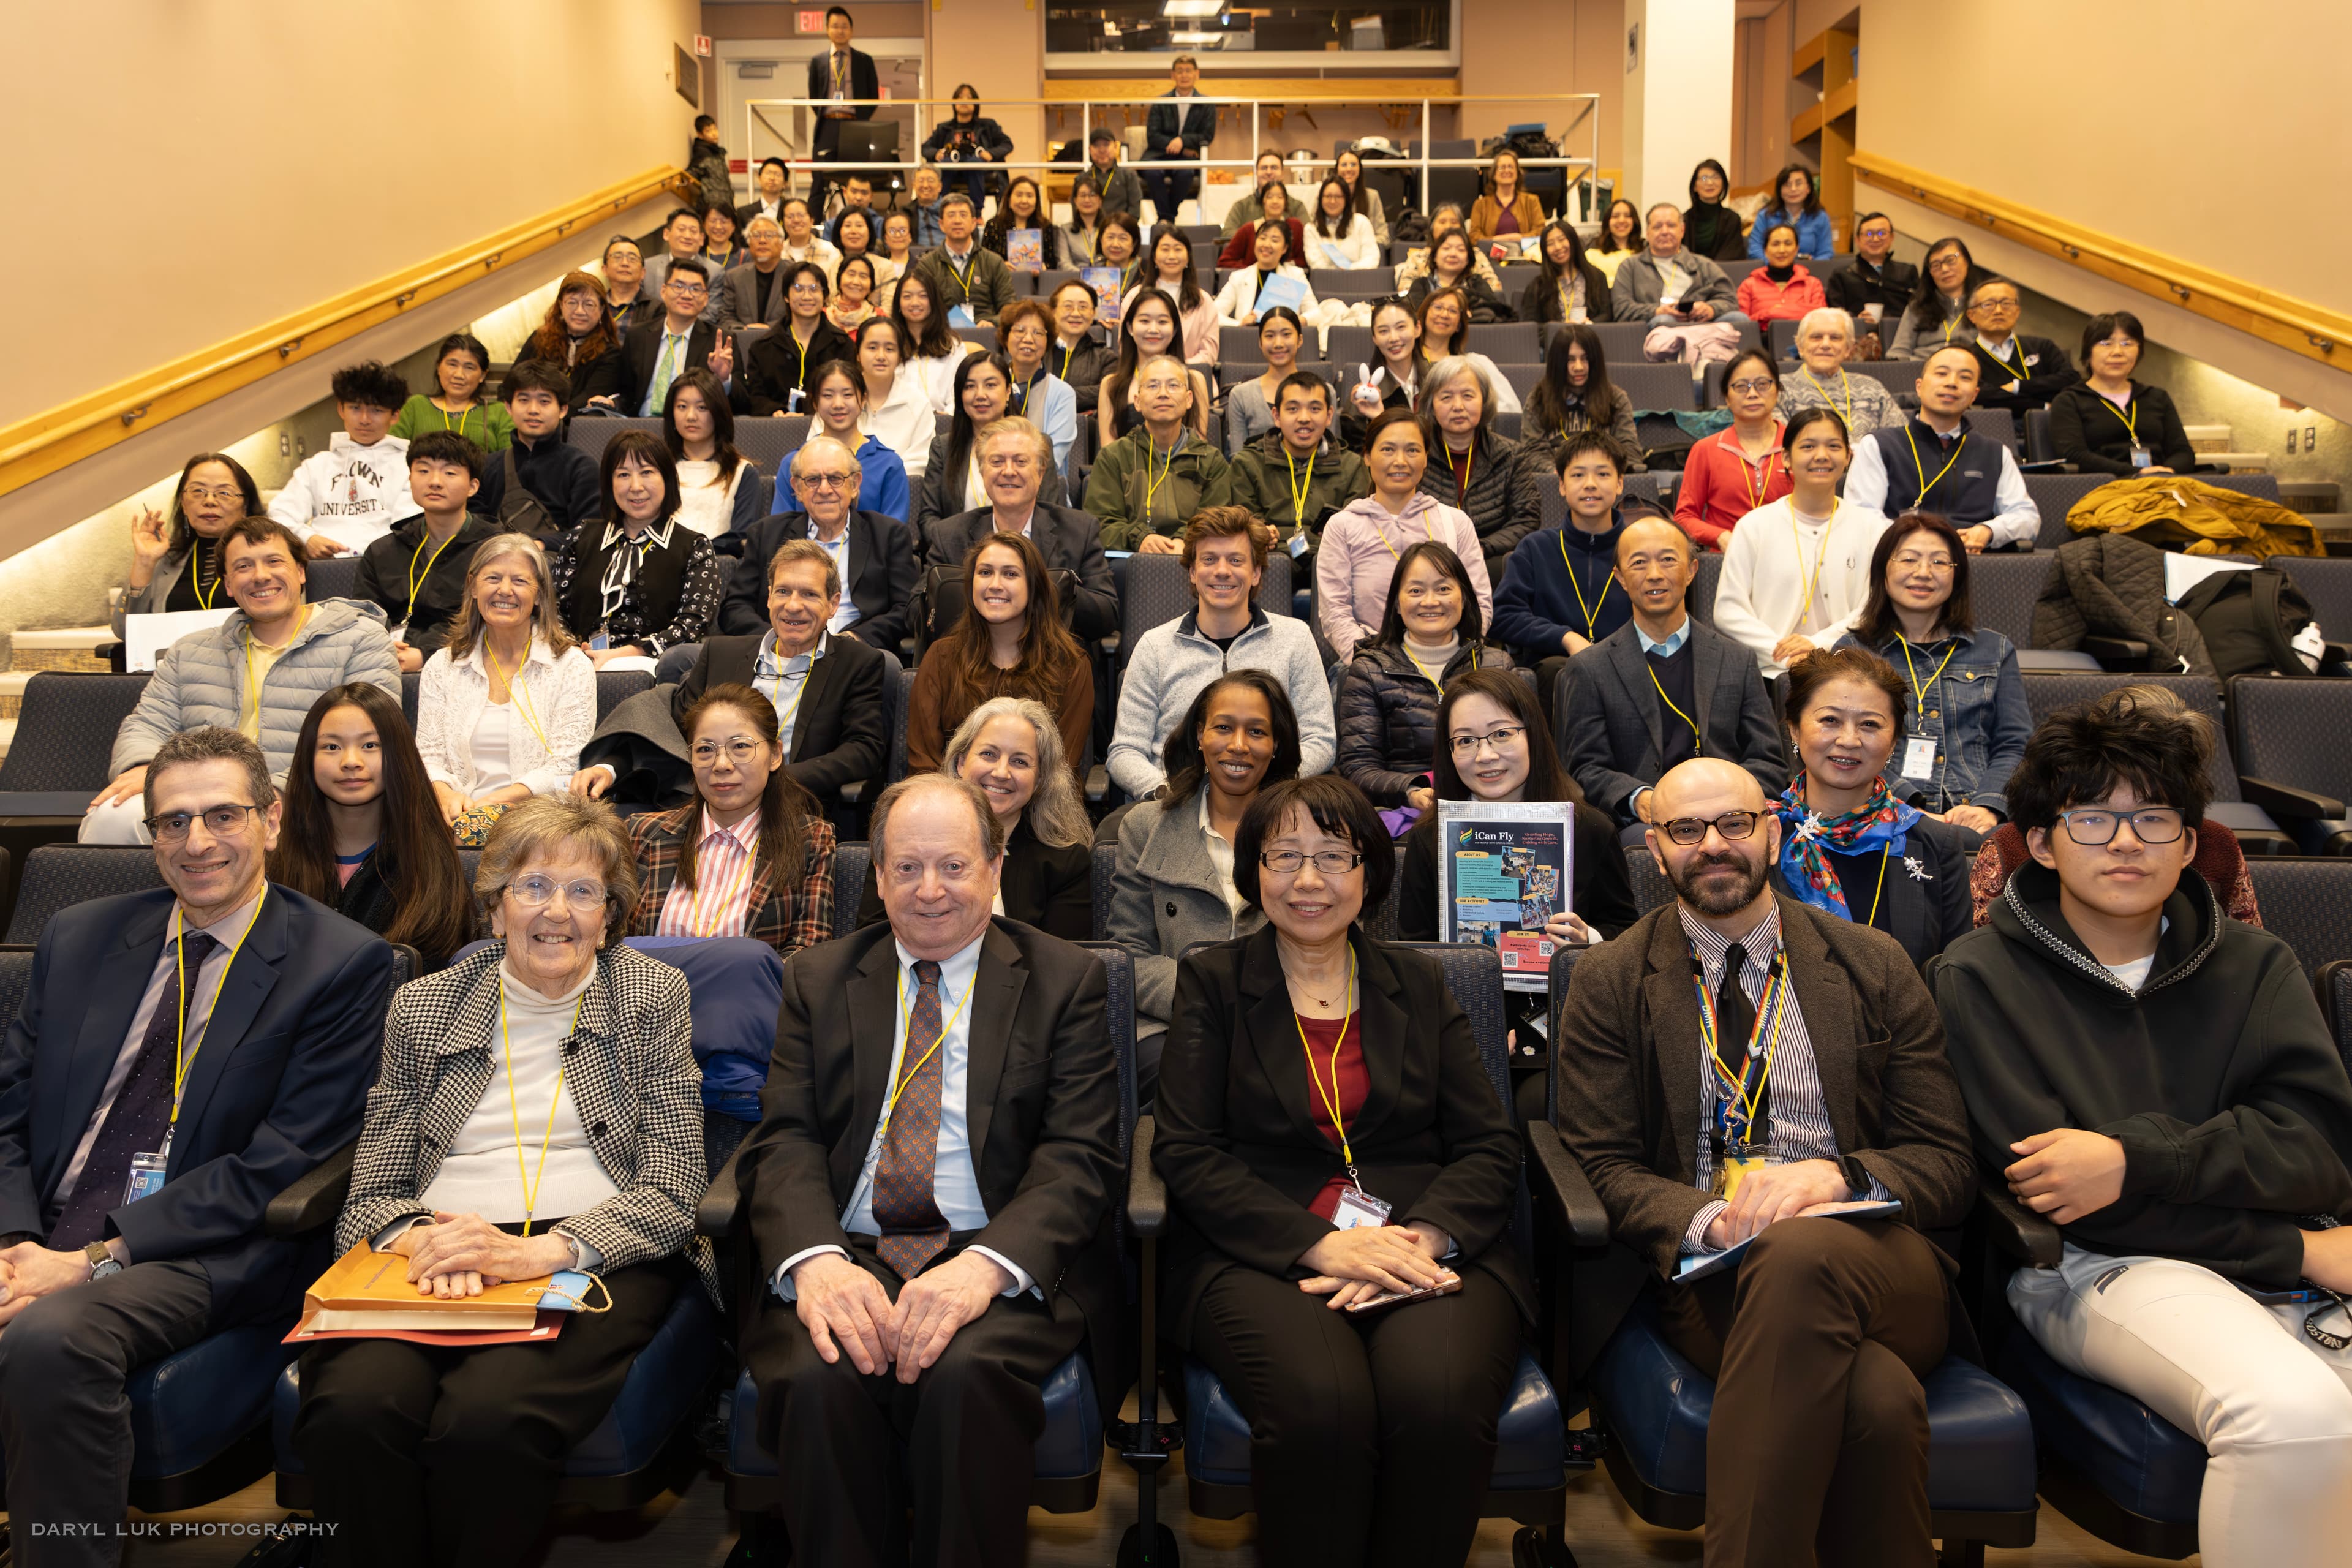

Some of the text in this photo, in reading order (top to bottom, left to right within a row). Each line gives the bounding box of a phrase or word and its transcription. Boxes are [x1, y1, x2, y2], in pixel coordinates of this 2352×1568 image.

[800, 11, 824, 31] EXIT
[320, 499, 385, 515] UNIVERSIT
[1474, 831, 1514, 842] iCan Fly
[1702, 1005, 1714, 1028] DMH
[1757, 997, 1772, 1029] MMHC
